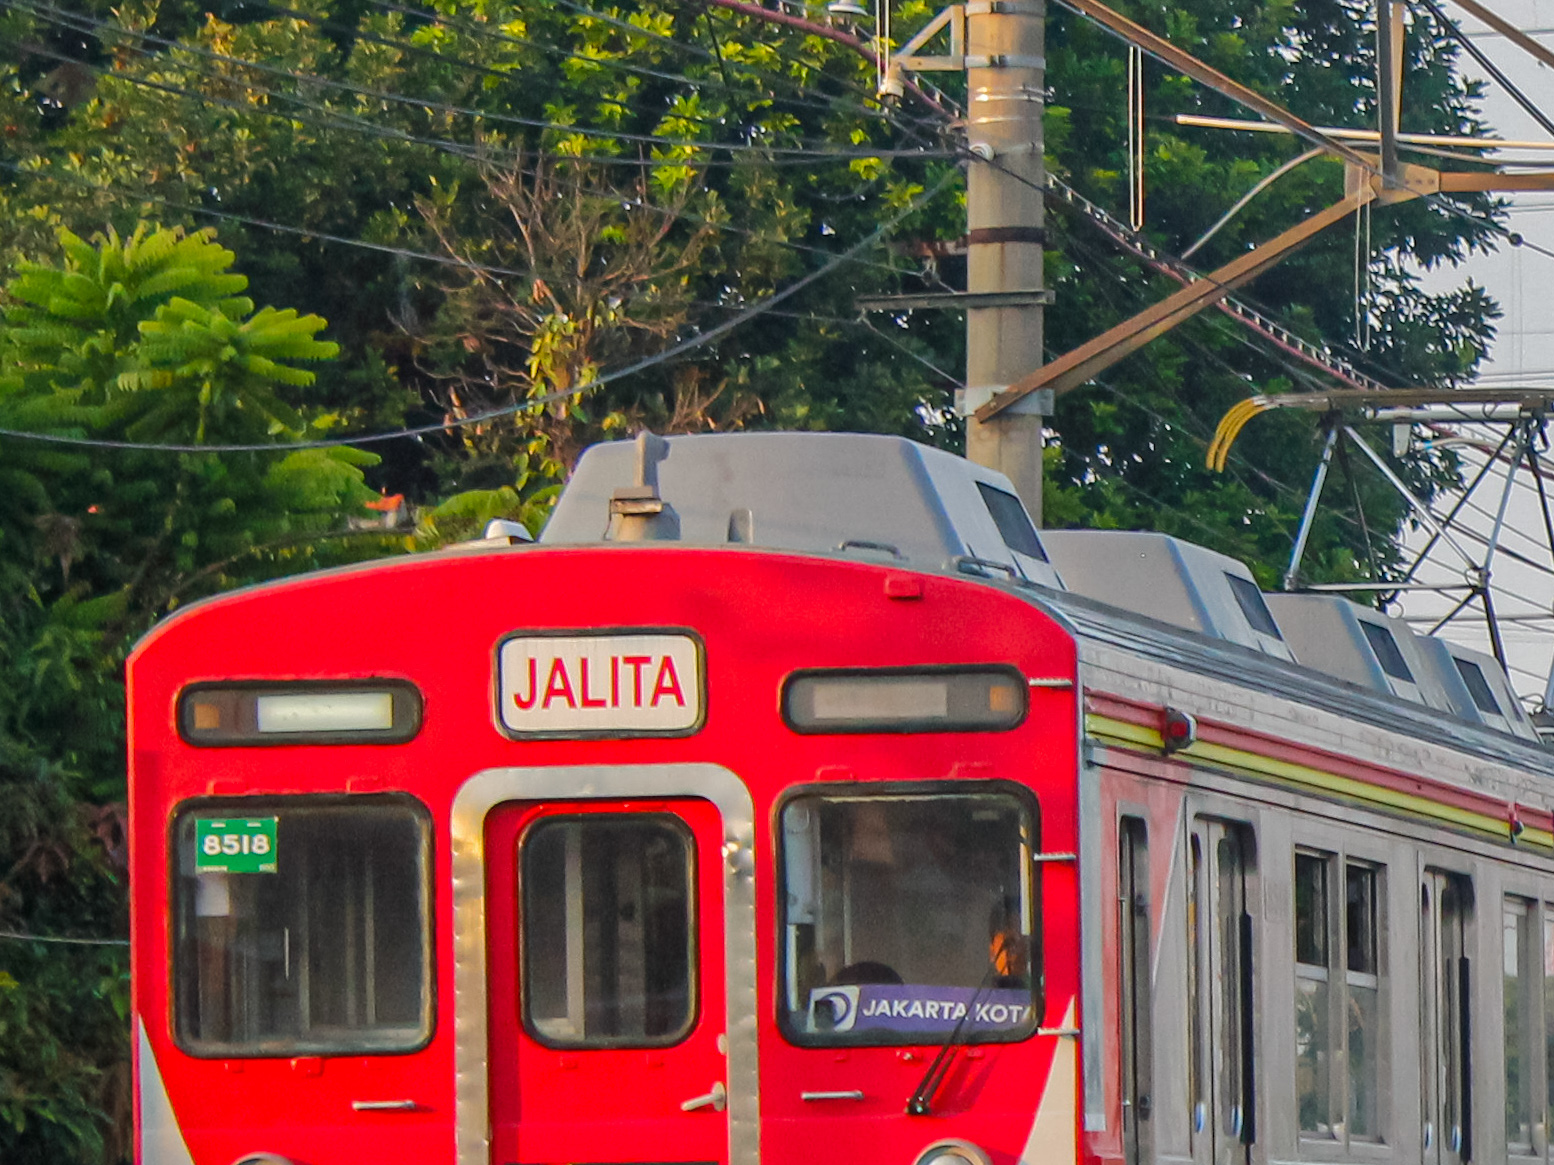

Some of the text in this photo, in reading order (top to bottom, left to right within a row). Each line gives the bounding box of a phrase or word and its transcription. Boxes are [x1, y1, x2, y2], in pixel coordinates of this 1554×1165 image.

[513, 656, 686, 709] JALITA
[203, 834, 271, 855] 8518
[863, 999, 968, 1020] JAKARTA
